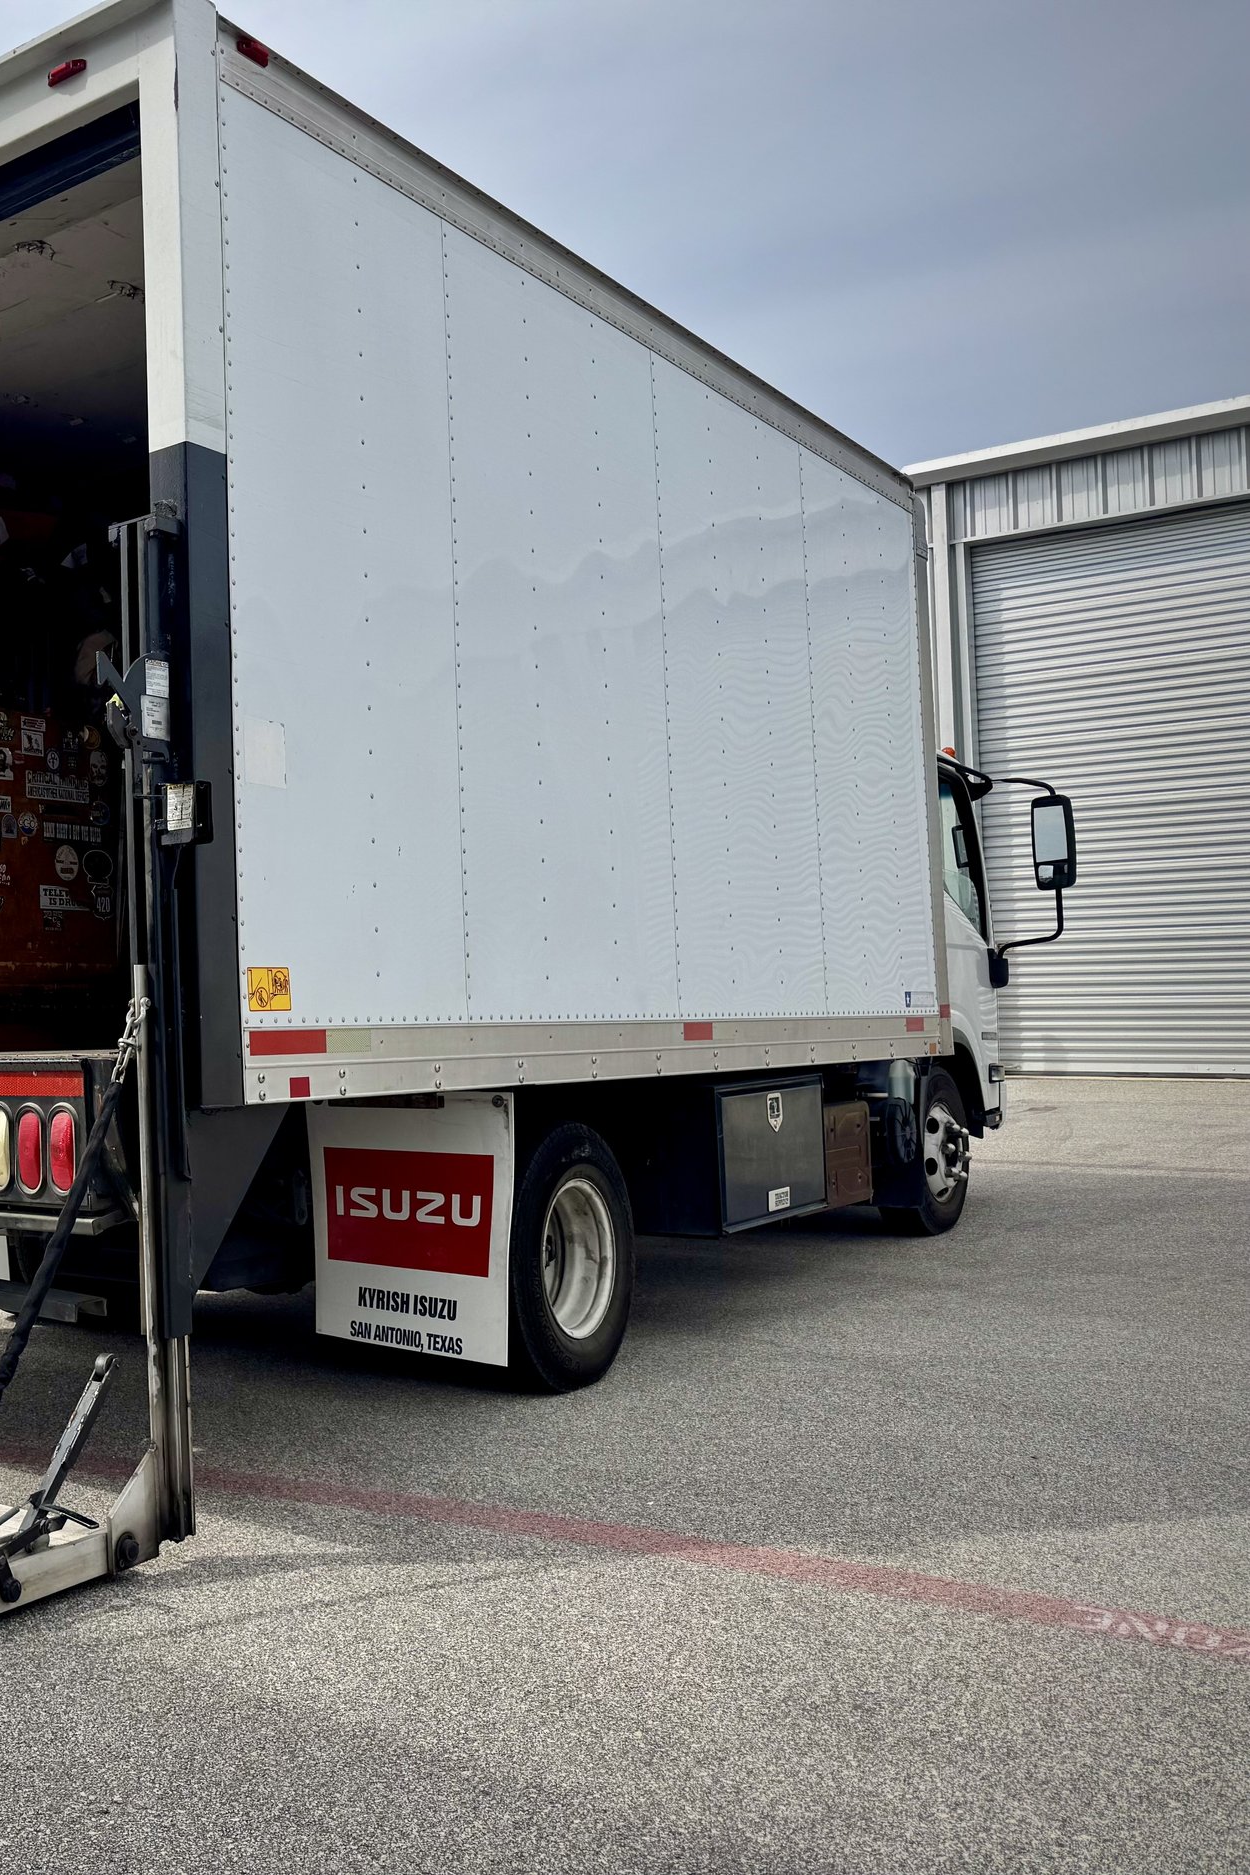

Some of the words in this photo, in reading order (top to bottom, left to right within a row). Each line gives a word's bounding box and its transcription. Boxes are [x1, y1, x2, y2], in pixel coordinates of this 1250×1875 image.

[49, 898, 57, 906] IS
[96, 896, 110, 912] 420
[335, 1185, 482, 1228] ISUZU
[358, 1286, 410, 1315] KYRISH
[413, 1294, 458, 1322] ISUZU
[350, 1320, 371, 1340] SAN
[373, 1325, 424, 1353] ANTONIO,
[426, 1332, 463, 1356] TEXAS
